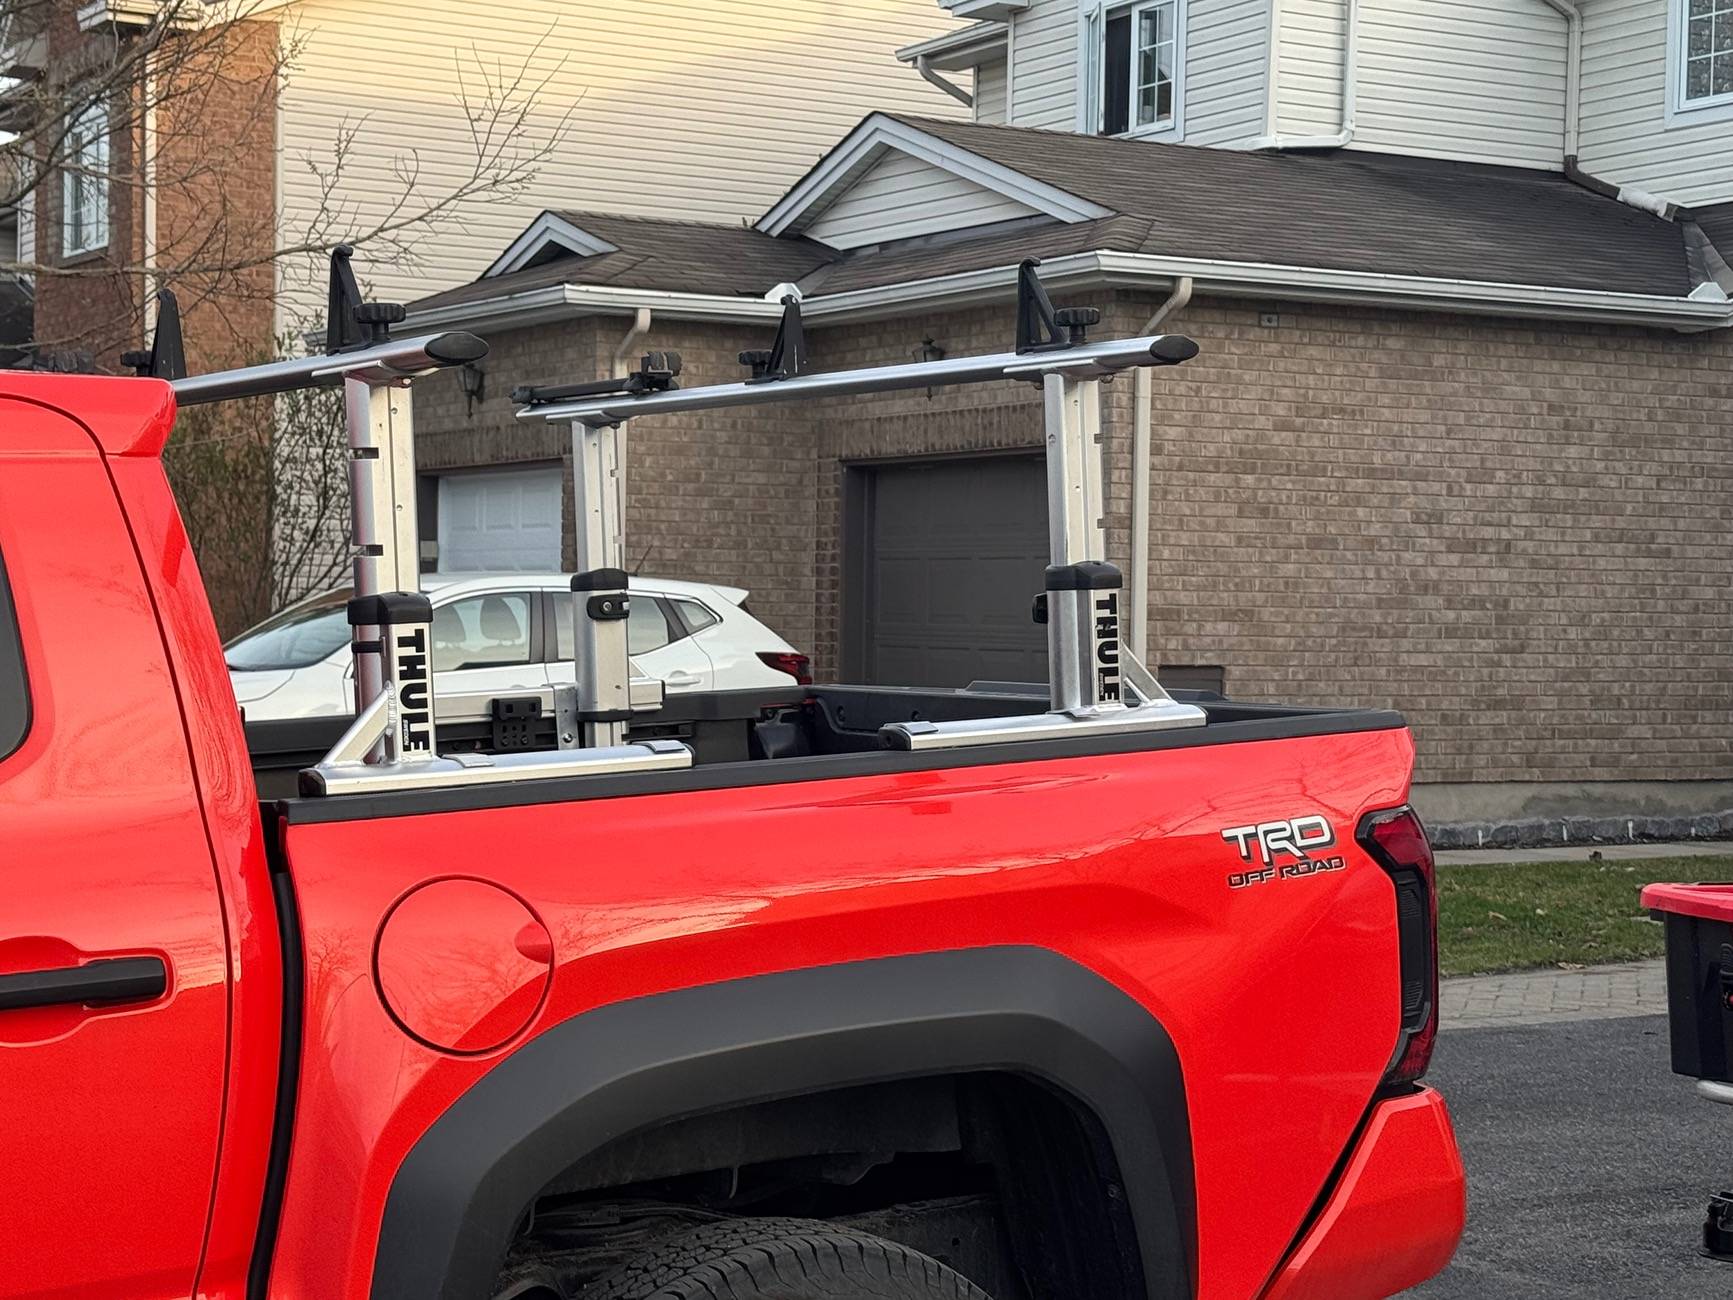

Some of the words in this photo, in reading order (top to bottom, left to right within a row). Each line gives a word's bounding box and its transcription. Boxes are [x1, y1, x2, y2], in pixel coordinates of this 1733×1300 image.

[1096, 593, 1119, 701] THULE
[397, 628, 430, 752] THULE
[1221, 815, 1335, 866] TRD
[1228, 869, 1276, 889] OFF
[1279, 856, 1346, 880] ROAD
